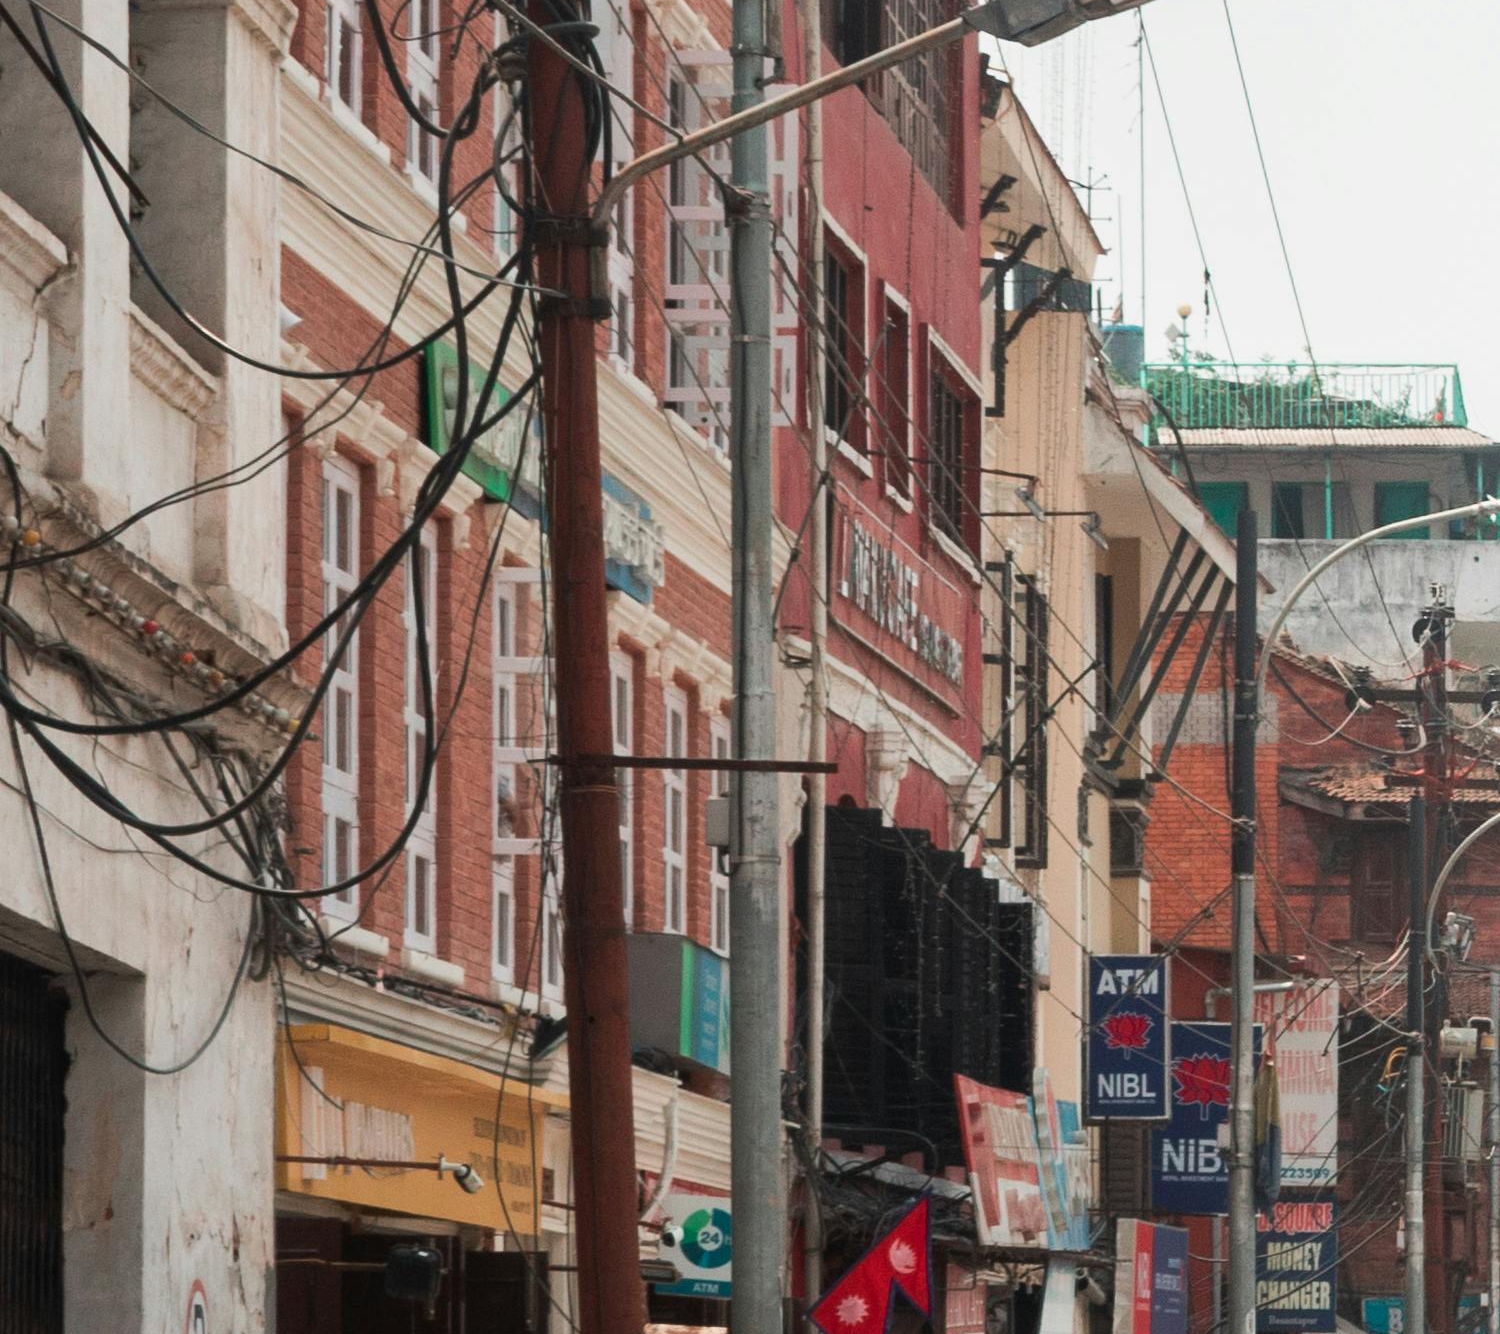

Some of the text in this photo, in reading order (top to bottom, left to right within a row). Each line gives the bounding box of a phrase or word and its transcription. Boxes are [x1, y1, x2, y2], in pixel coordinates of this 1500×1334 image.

[1096, 969, 1158, 995] ATM
[1098, 1073, 1156, 1098] NIBL
[1161, 1139, 1229, 1173] NIB
[1272, 1201, 1334, 1235] SQUARE
[701, 1231, 720, 1244] 24
[1267, 1242, 1323, 1271] MONEY
[692, 1283, 719, 1294] ATM
[1257, 1280, 1332, 1311] CHANGER
